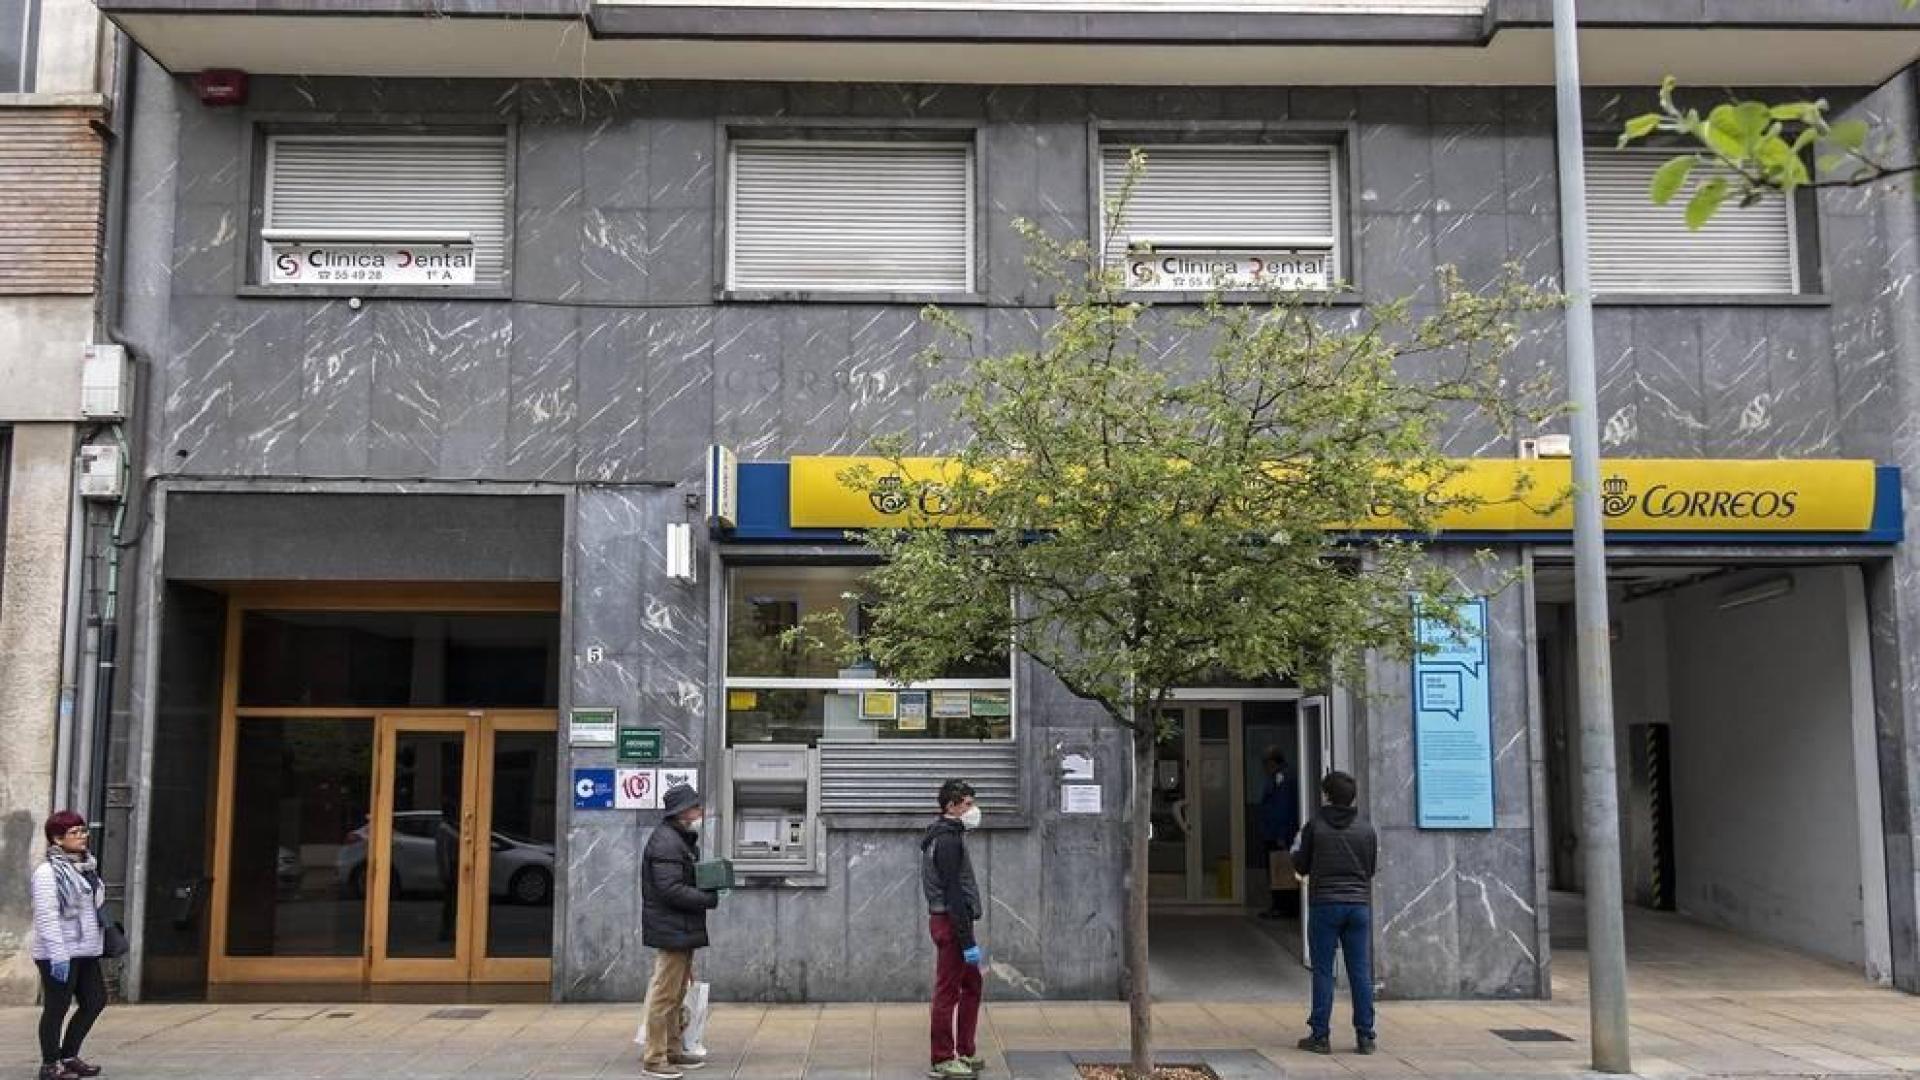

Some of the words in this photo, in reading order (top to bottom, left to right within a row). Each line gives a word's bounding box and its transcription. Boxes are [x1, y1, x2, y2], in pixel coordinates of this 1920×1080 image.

[397, 250, 472, 268] Dental
[1642, 484, 1798, 518] CORREOS
[591, 648, 600, 662] 5
